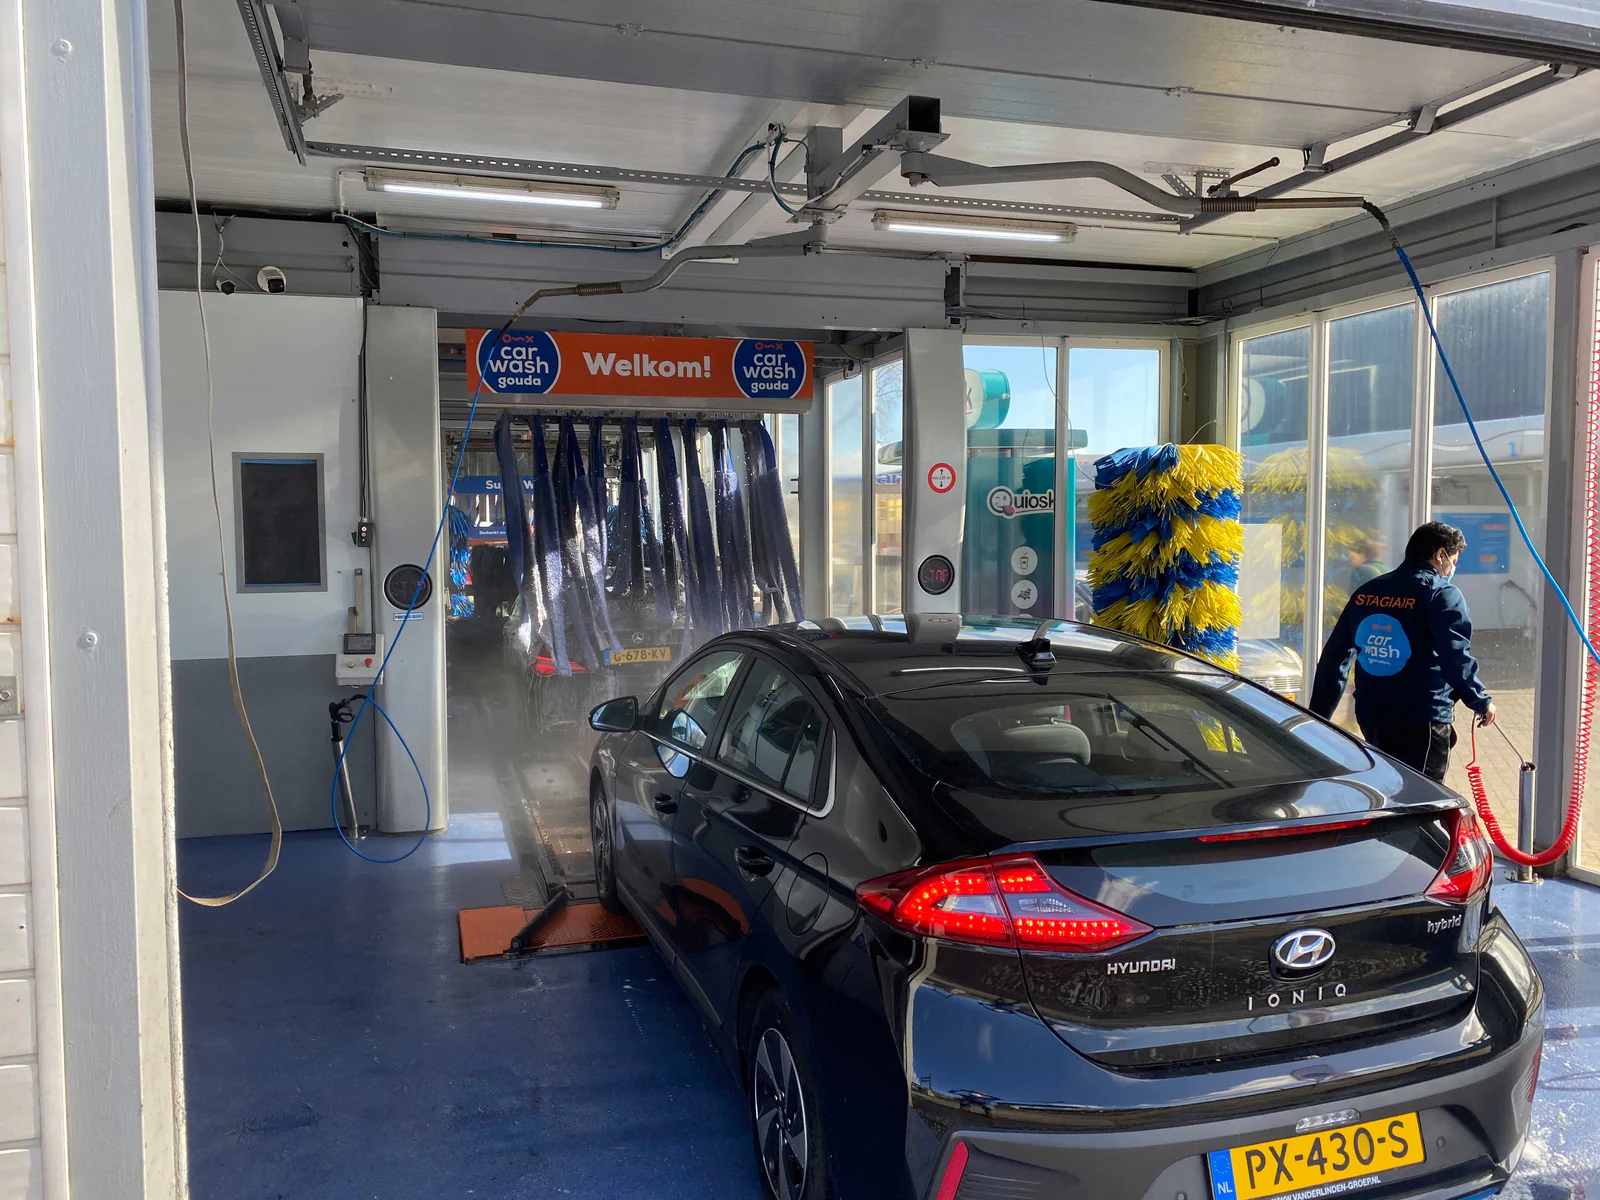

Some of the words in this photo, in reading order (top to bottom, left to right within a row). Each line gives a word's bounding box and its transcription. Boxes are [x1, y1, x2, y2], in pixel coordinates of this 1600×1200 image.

[500, 346, 538, 360] car
[753, 352, 786, 366] car
[488, 356, 549, 374] wash
[582, 351, 711, 378] Welkom!
[742, 362, 796, 379] wash
[498, 375, 542, 389] gouda
[750, 381, 789, 394] gouda
[1355, 594, 1416, 610] STAGIAIR
[1366, 634, 1393, 647] car
[614, 648, 667, 662] G-678-KV
[1361, 645, 1400, 659] wash
[1427, 914, 1462, 934] hybrid
[1107, 958, 1176, 975] HYUNDAI
[1245, 1120, 1409, 1189] PX-430-S
[1217, 1181, 1233, 1195] NL
